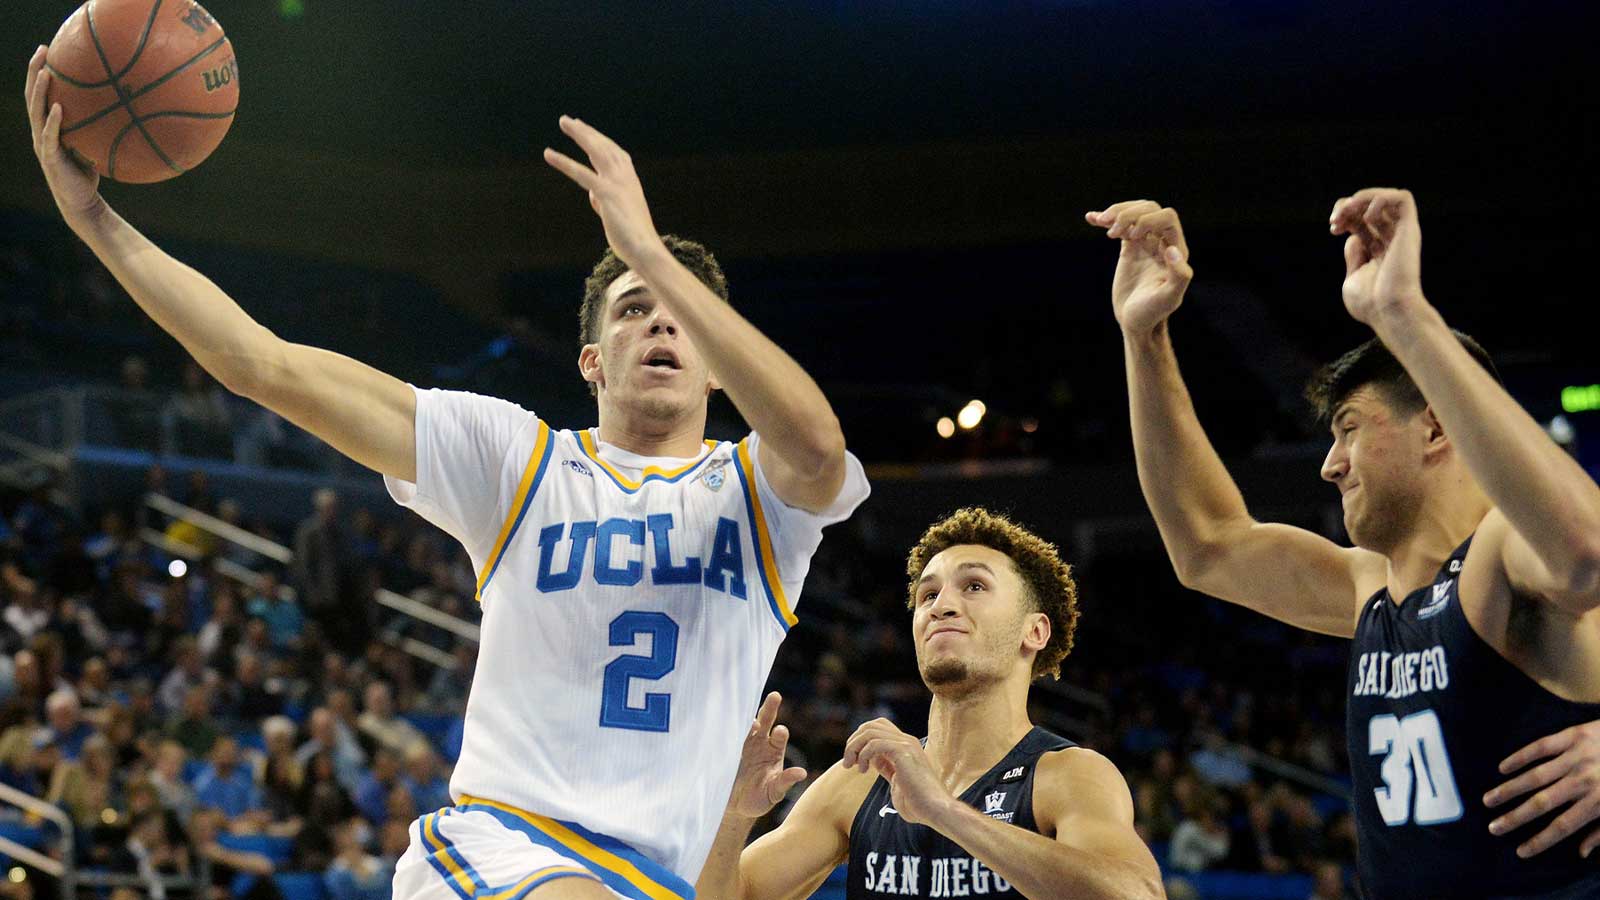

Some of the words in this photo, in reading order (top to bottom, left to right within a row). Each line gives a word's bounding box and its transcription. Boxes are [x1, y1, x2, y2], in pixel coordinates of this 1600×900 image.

[536, 513, 748, 600] UCLA
[599, 609, 680, 733] 2
[1385, 645, 1449, 699] DIEGO
[1368, 708, 1465, 827] 30
[864, 851, 921, 896] SAN
